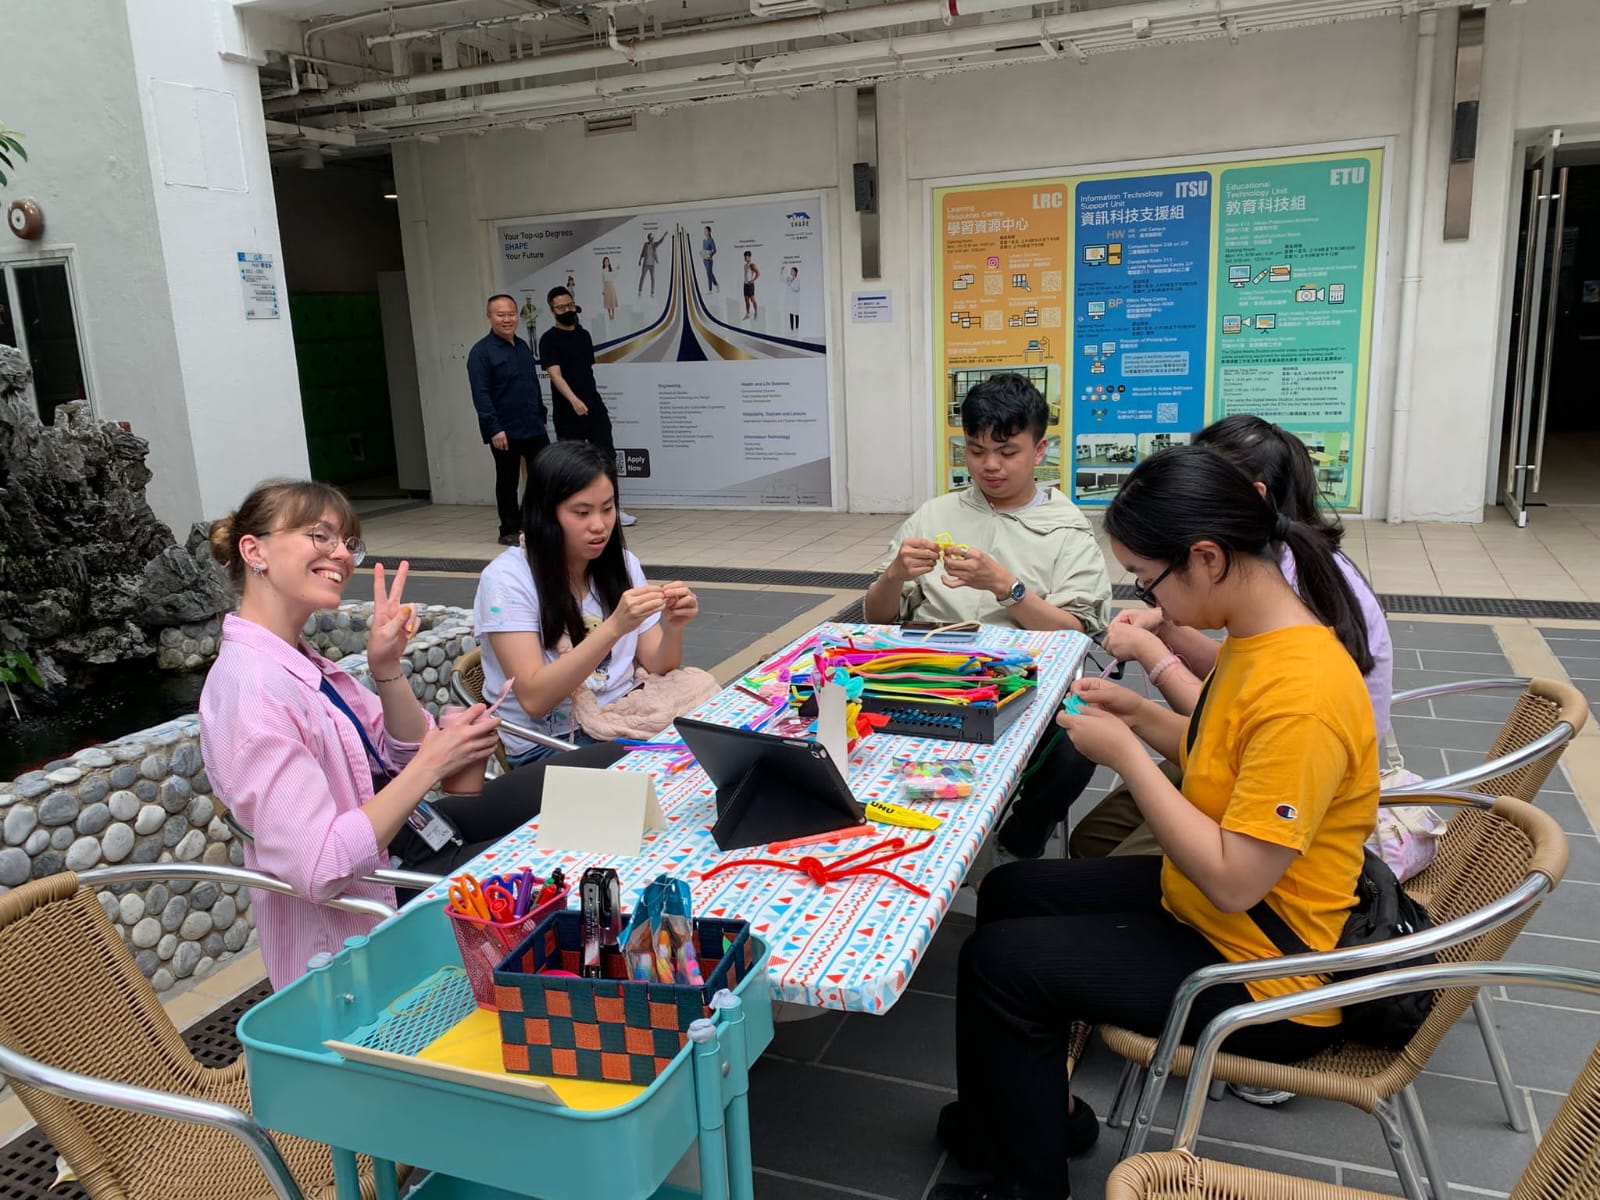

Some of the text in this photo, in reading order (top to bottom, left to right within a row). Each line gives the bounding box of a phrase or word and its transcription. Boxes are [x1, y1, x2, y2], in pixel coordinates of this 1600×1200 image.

[1330, 167, 1365, 186] ETU
[1175, 180, 1208, 198] ITSU
[1225, 181, 1271, 191] Educational
[1080, 190, 1164, 202] Information Technology
[1226, 187, 1288, 199] Technology Unit
[1032, 192, 1063, 209] LRC
[1080, 200, 1126, 210] Support Unit
[1225, 195, 1307, 216] 教育科技組
[1081, 204, 1185, 227] 資訊科技支援組
[947, 217, 1029, 236] 學習資源中心
[504, 230, 573, 241] Your Top-up Degrees
[1106, 230, 1125, 240] HW
[504, 242, 529, 251] SHAPE
[505, 251, 544, 260] Your Future
[1108, 298, 1124, 308] BP
[627, 455, 646, 464] Apply
[627, 464, 642, 472] Now
[870, 800, 895, 814] UHU
